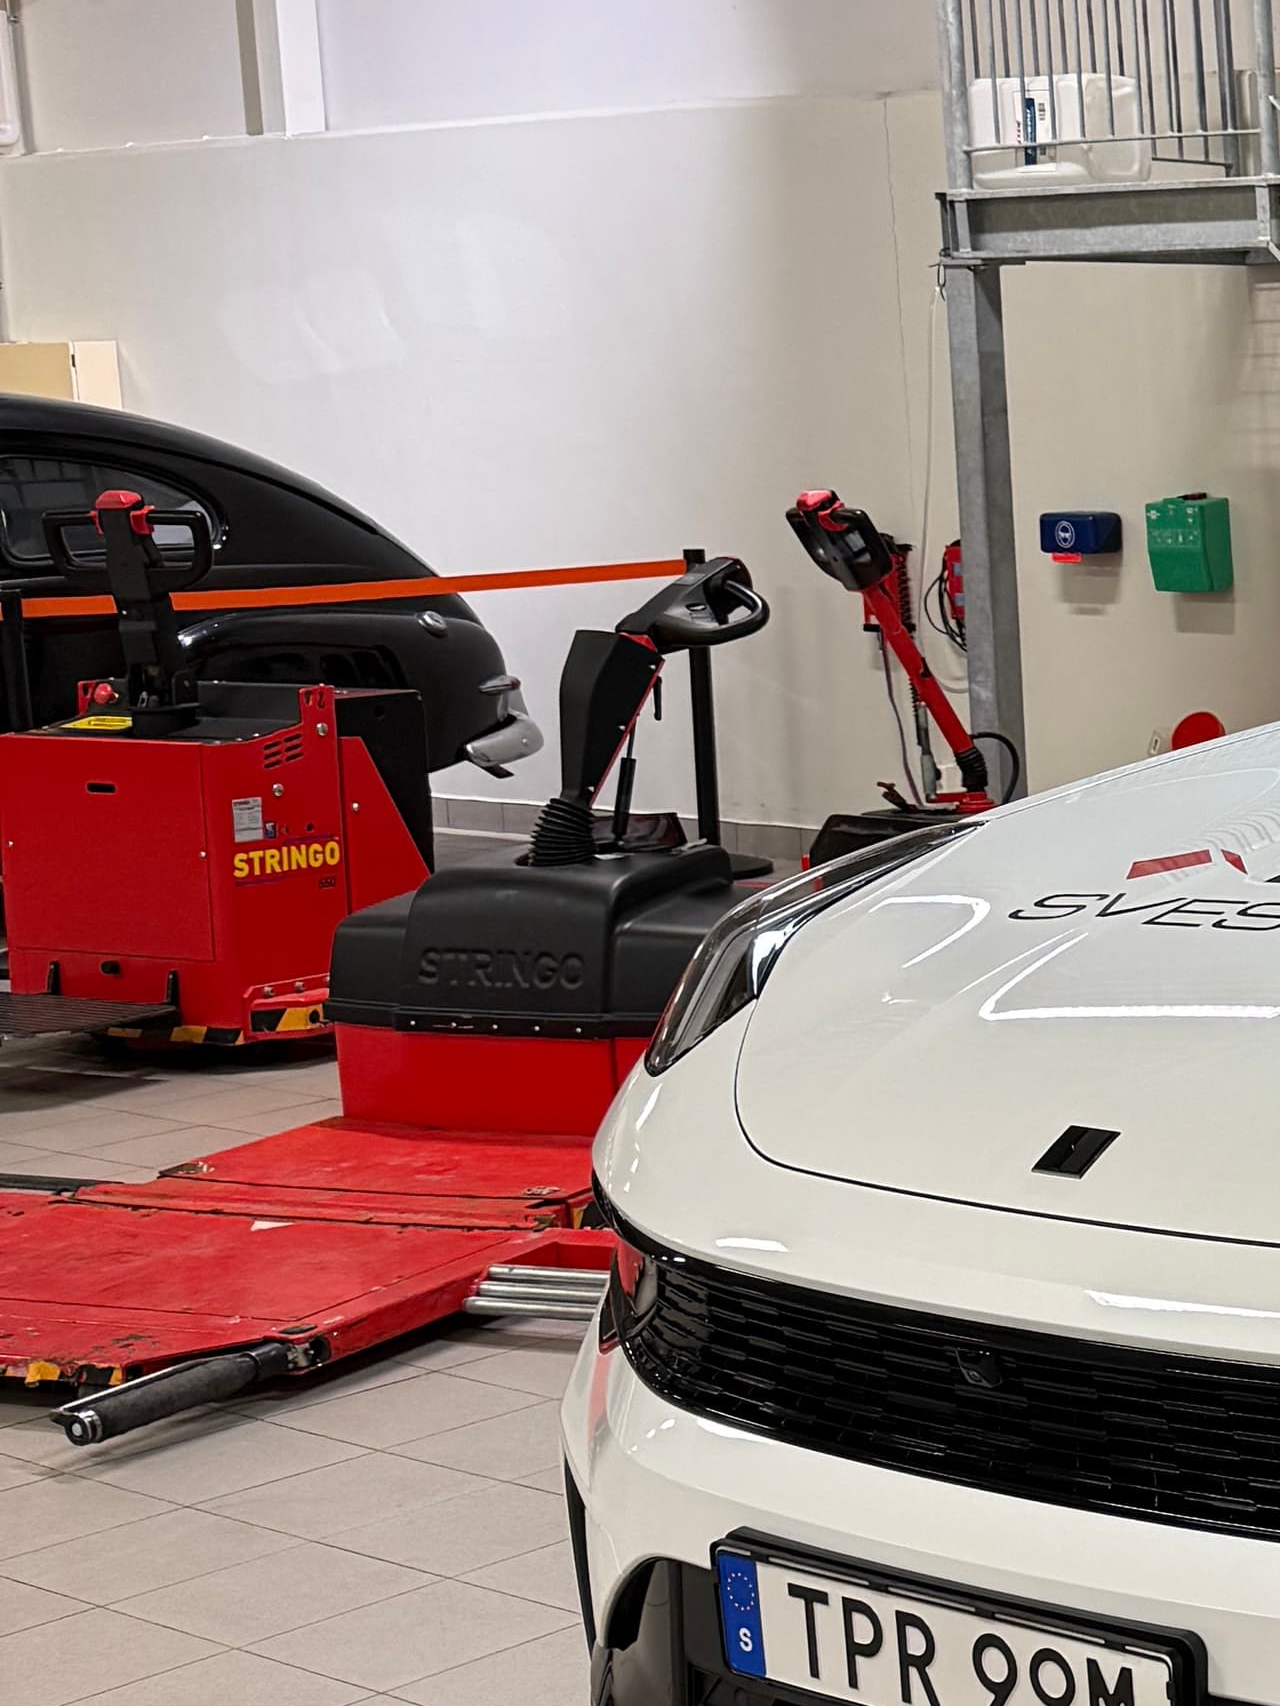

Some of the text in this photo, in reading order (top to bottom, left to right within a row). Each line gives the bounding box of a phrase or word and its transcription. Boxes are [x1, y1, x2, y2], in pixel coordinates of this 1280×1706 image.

[233, 841, 340, 878] STRINGO
[418, 948, 585, 989] STRINGO
[738, 1627, 753, 1653] S
